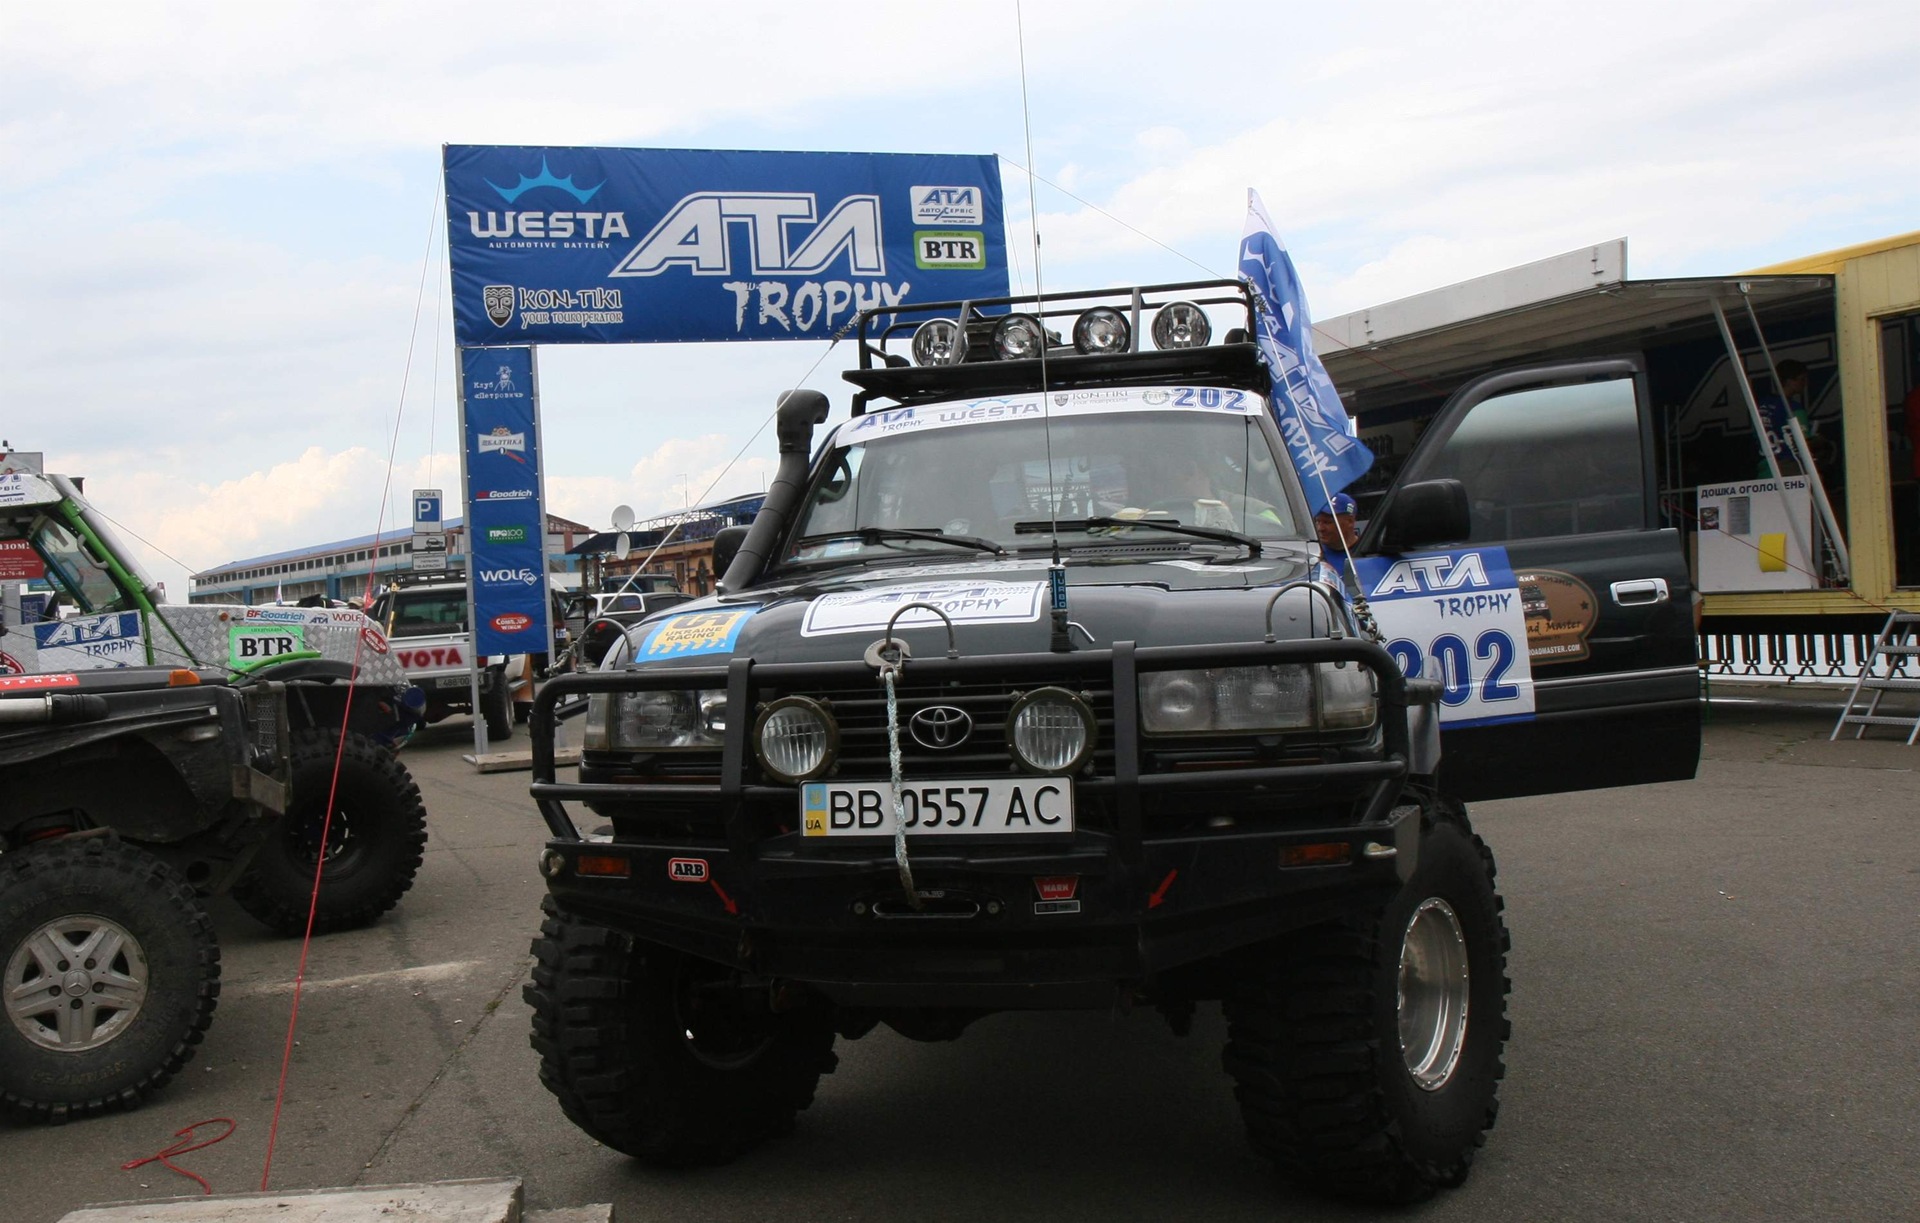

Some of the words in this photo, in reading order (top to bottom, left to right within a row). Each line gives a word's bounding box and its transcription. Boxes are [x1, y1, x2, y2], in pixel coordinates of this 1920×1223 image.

[466, 212, 630, 238] WESTA
[488, 241, 557, 249] AUTOMOTIVE
[563, 241, 611, 249] BATTERY
[923, 240, 977, 259] BTR
[518, 286, 624, 310] KON-TIKI
[722, 281, 911, 332] TROPHY
[1072, 390, 1128, 400] KON-TIKI
[1170, 387, 1248, 412] 202
[938, 403, 1040, 424] WESTA
[882, 418, 925, 433] TROPHY
[1700, 486, 1736, 499] ДОШКА
[1738, 480, 1805, 494] ОГОЛОЕНЬ
[479, 568, 530, 582] WOLF
[1518, 574, 1536, 583] 4x4
[1057, 570, 1066, 608] TURBO
[1433, 593, 1512, 619] TROPHY
[246, 609, 305, 622] BFGoodrich
[332, 613, 363, 623] WOLF
[665, 626, 723, 637] UKRAINE
[666, 632, 715, 641] RACING
[84, 639, 135, 657] TROPHY
[239, 637, 294, 657] BTR
[830, 789, 884, 829] BB
[1005, 785, 1062, 827] AC
[805, 818, 823, 831] UA
[673, 862, 704, 877] ARB
